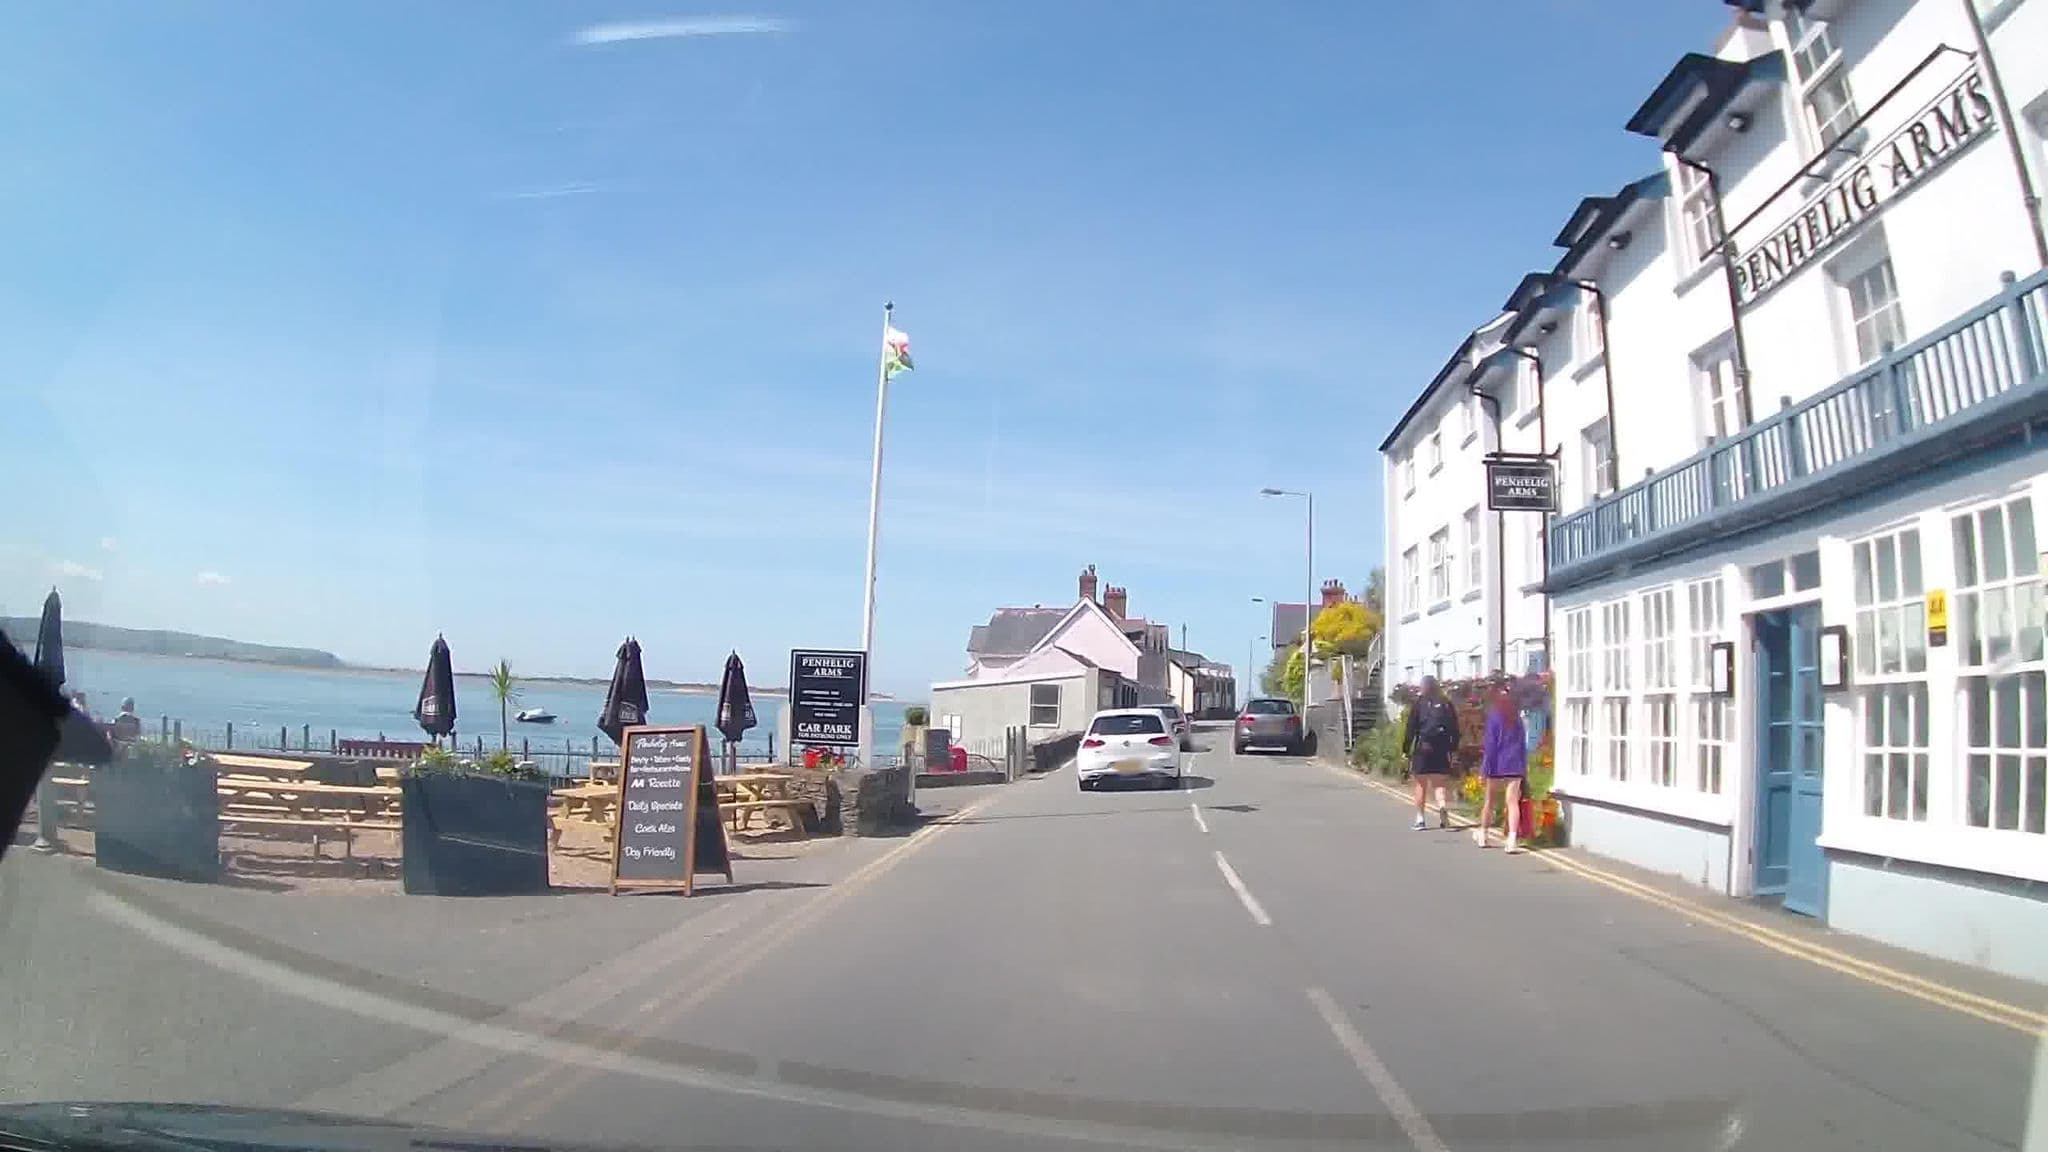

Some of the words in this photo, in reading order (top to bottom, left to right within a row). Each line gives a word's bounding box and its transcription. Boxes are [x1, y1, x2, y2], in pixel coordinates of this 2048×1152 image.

[1882, 72, 1994, 188] ARMS
[1495, 476, 1549, 487] PENHELIG
[1508, 487, 1537, 496] ARMS
[802, 658, 854, 668] PENHELIG
[814, 668, 842, 676] ARMS
[798, 723, 820, 733] CAR
[824, 724, 852, 734] PARK
[625, 847, 641, 859] Dog
[643, 847, 676, 860] Friendly
